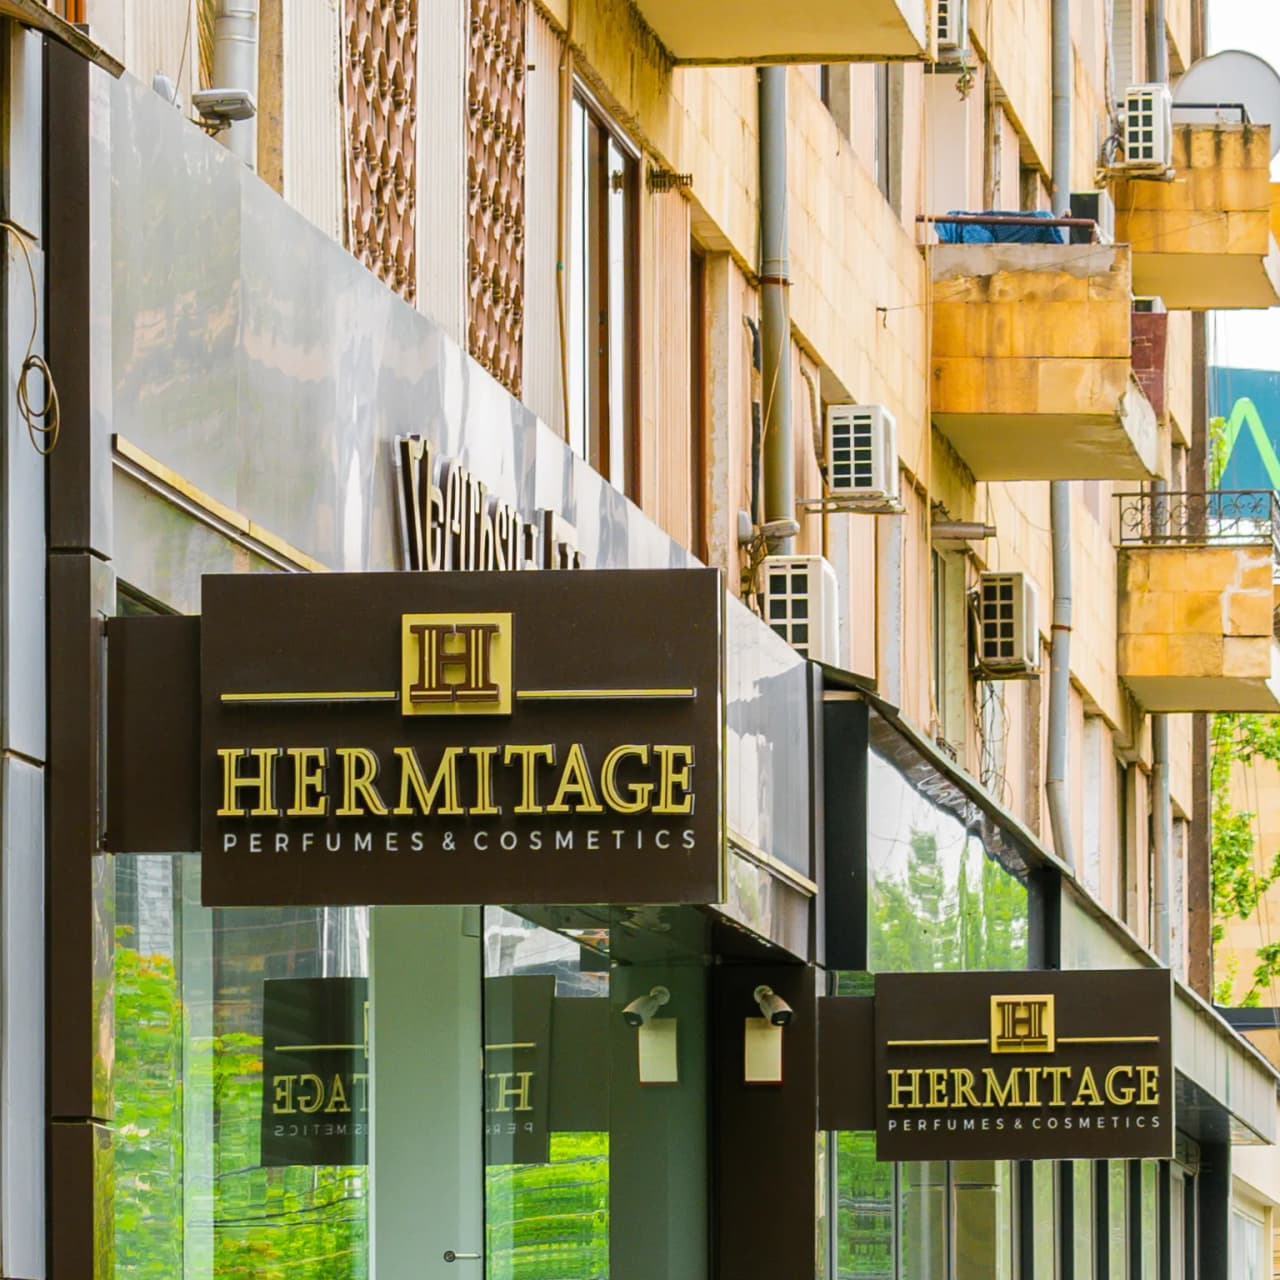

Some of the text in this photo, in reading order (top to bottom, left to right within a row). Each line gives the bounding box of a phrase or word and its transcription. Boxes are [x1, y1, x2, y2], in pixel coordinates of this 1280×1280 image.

[408, 622, 500, 704] H
[216, 743, 696, 817] HERMITAGE
[223, 829, 696, 854] PERFUMES & COSMETICS
[997, 1001, 1047, 1048] H
[886, 1065, 1160, 1109] HERMITAGE
[888, 1117, 1162, 1132] PERFUMES & COSMETICS
